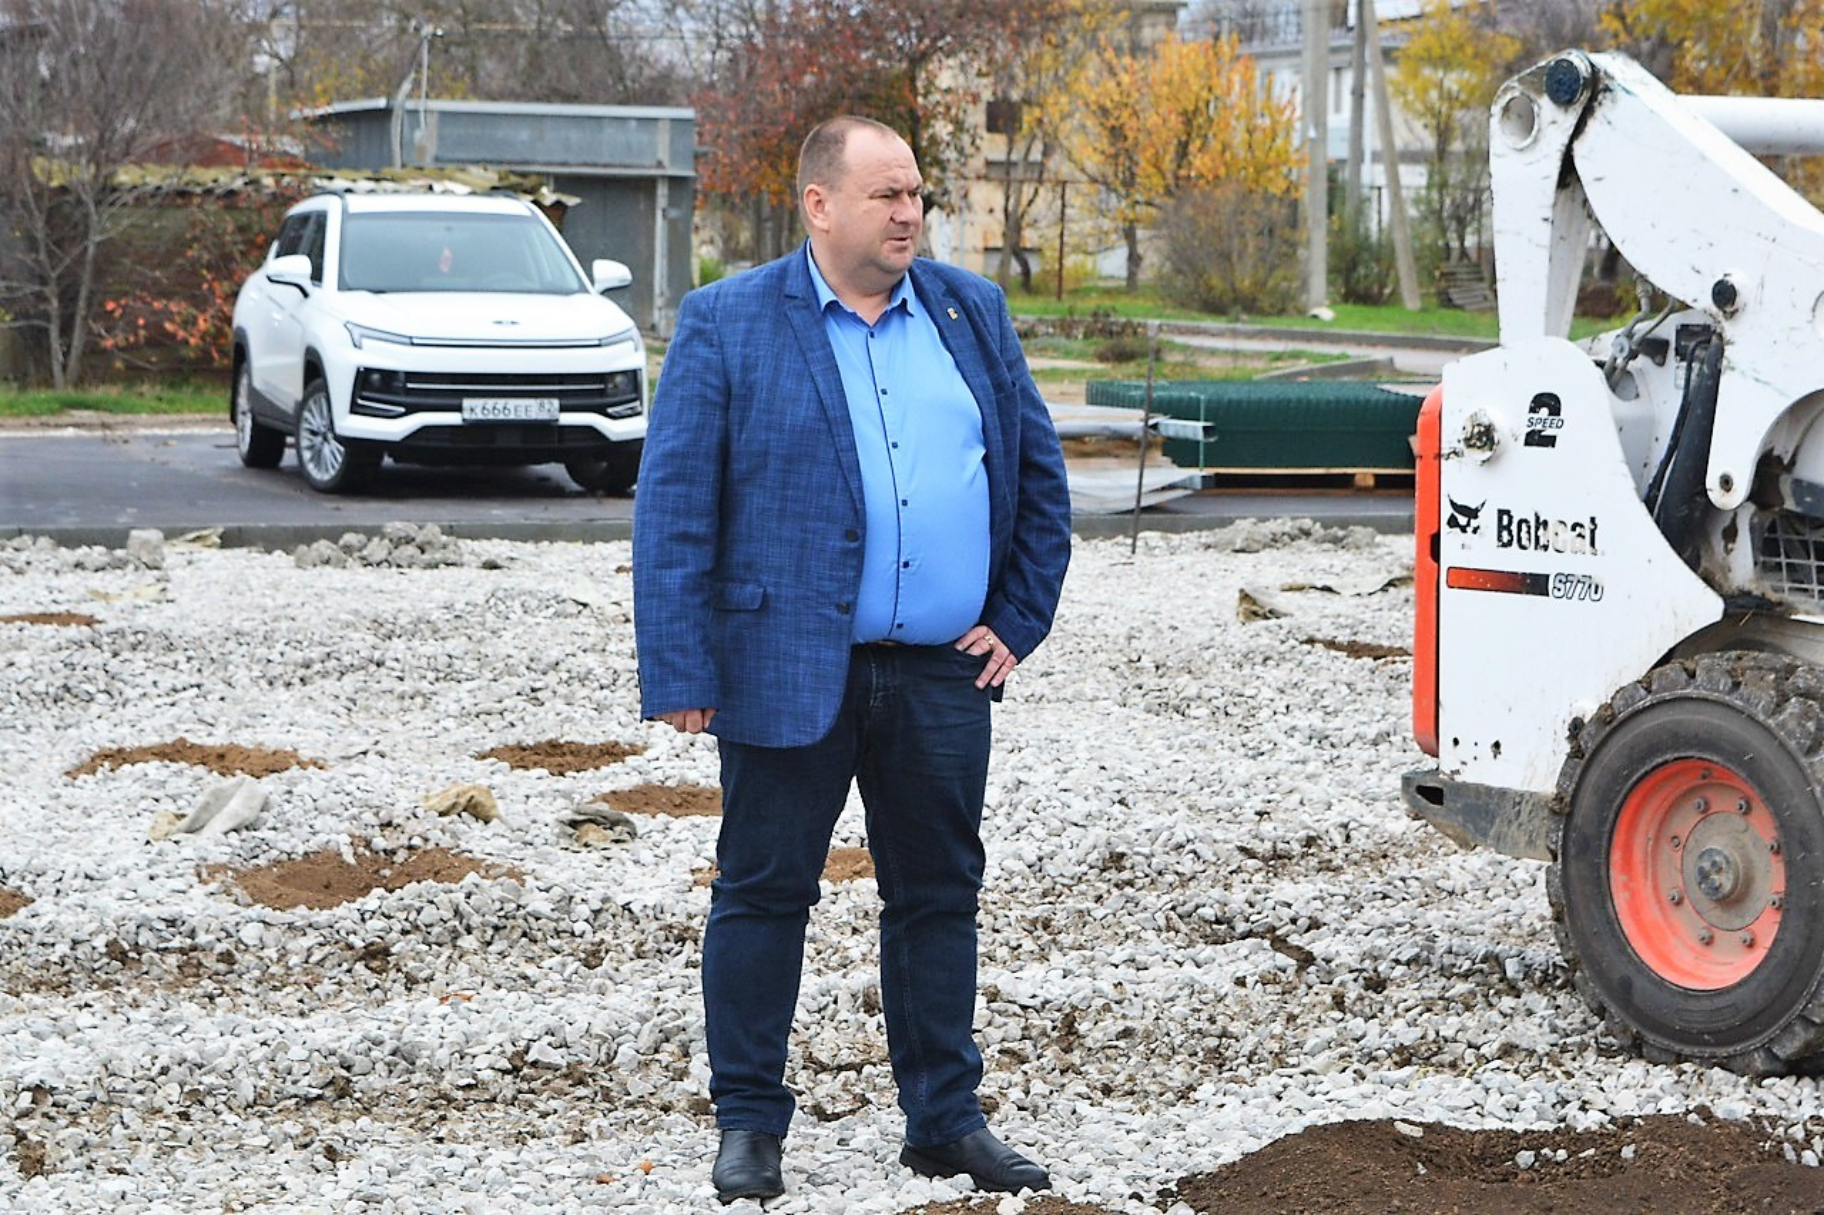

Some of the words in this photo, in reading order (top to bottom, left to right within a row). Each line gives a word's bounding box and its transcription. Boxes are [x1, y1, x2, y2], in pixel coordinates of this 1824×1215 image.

[1524, 392, 1562, 448] 2
[1526, 416, 1564, 430] SPEED
[1552, 572, 1604, 602] S770
